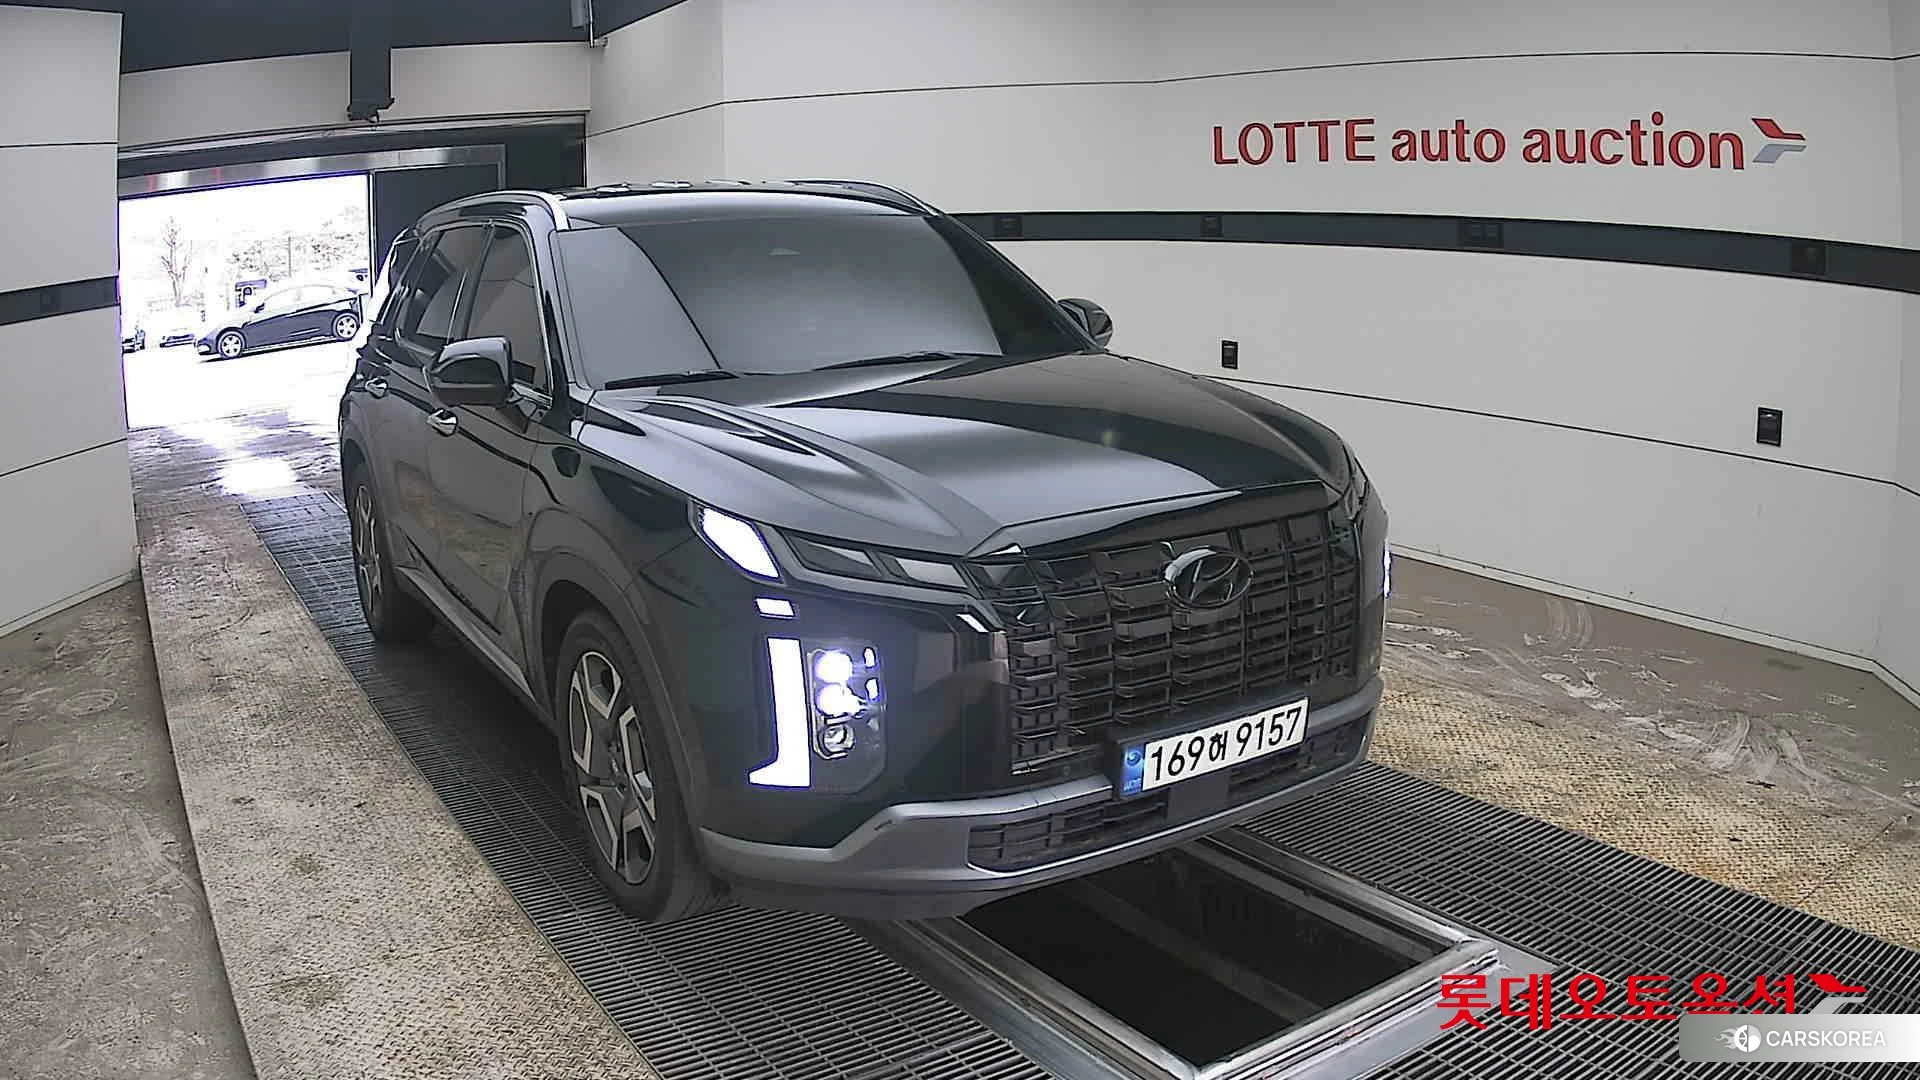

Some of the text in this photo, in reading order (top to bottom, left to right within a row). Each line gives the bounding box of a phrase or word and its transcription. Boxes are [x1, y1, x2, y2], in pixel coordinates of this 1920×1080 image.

[1213, 111, 1745, 170] LOTTE auto auction
[1151, 706, 1302, 782] 169허 9157
